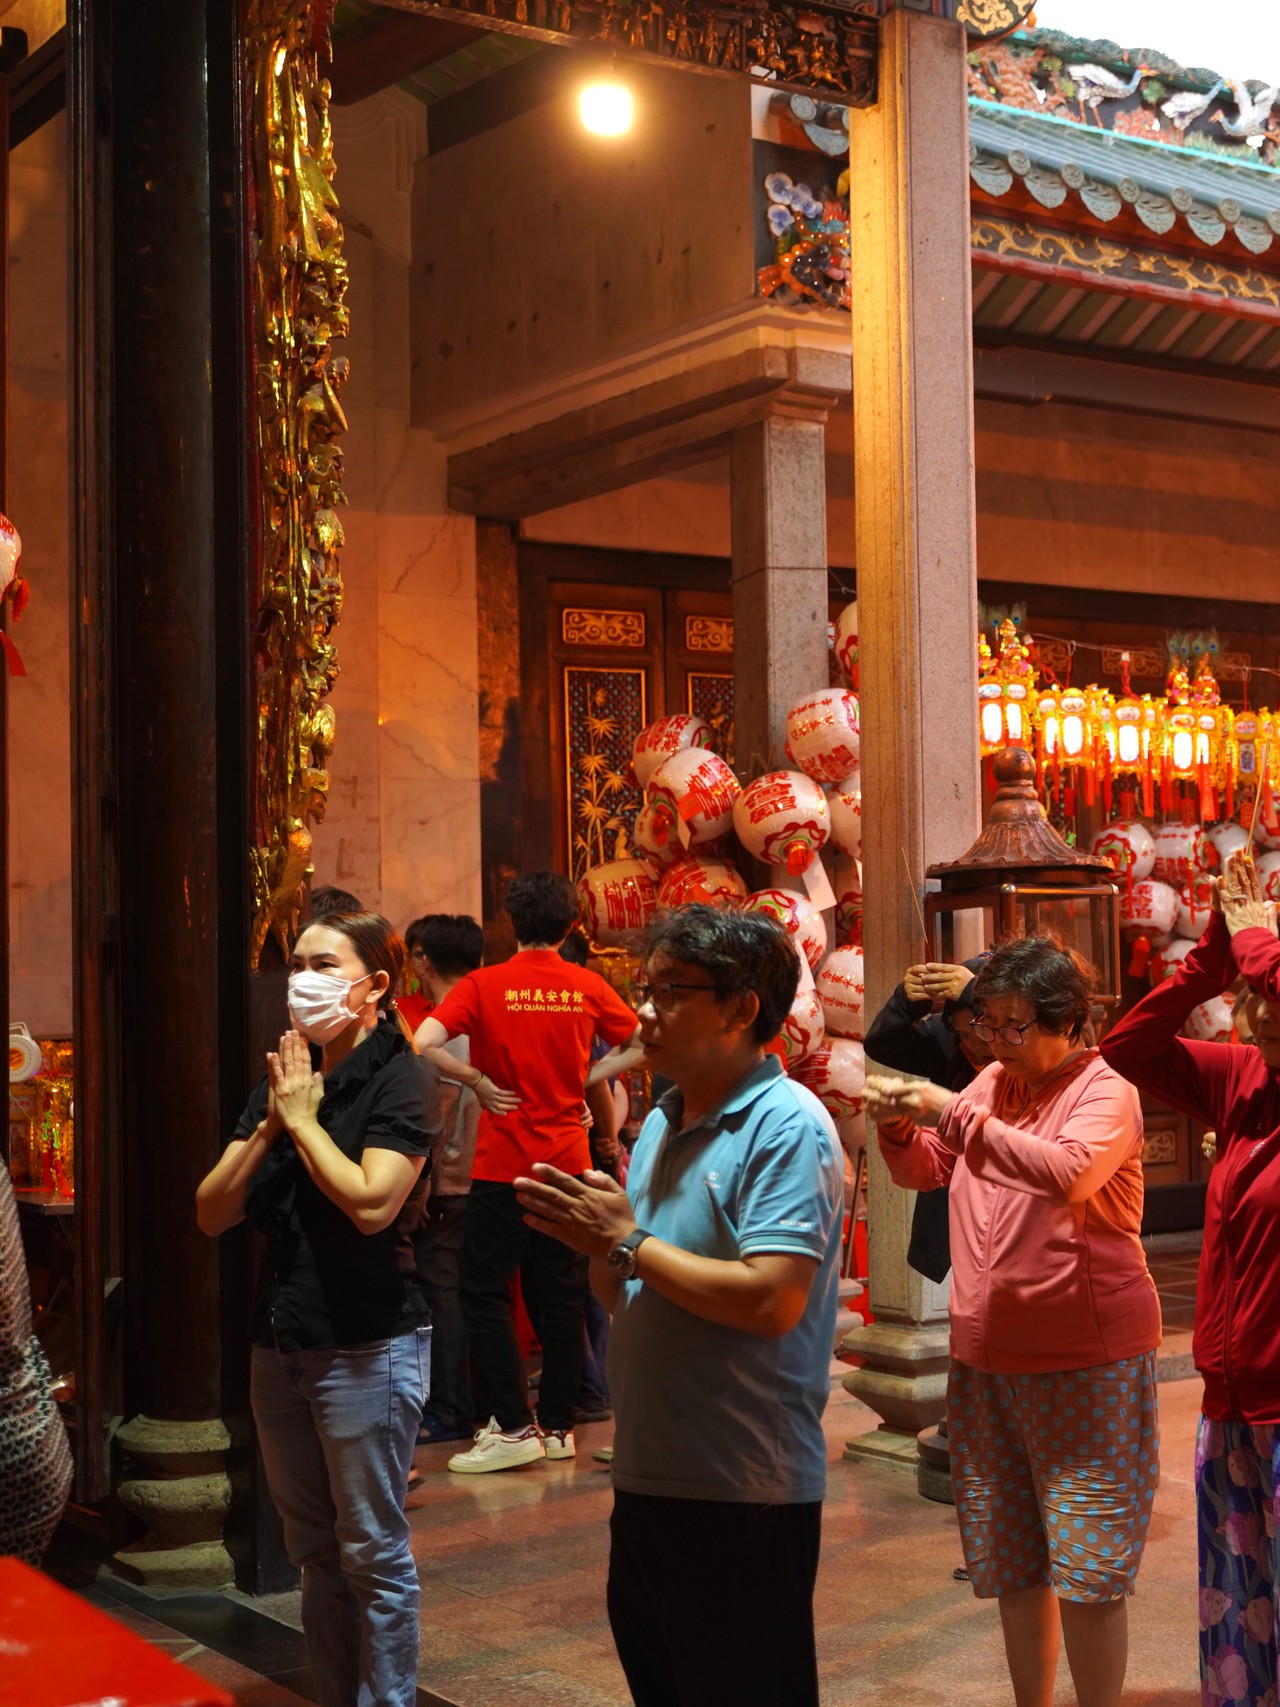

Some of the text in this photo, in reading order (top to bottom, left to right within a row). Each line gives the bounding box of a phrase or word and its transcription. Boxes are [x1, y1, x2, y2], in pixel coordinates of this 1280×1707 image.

[505, 988, 584, 1004] 潮州義安會館
[507, 1002, 583, 1013] HỘI QUÁN NGHĨA AN
